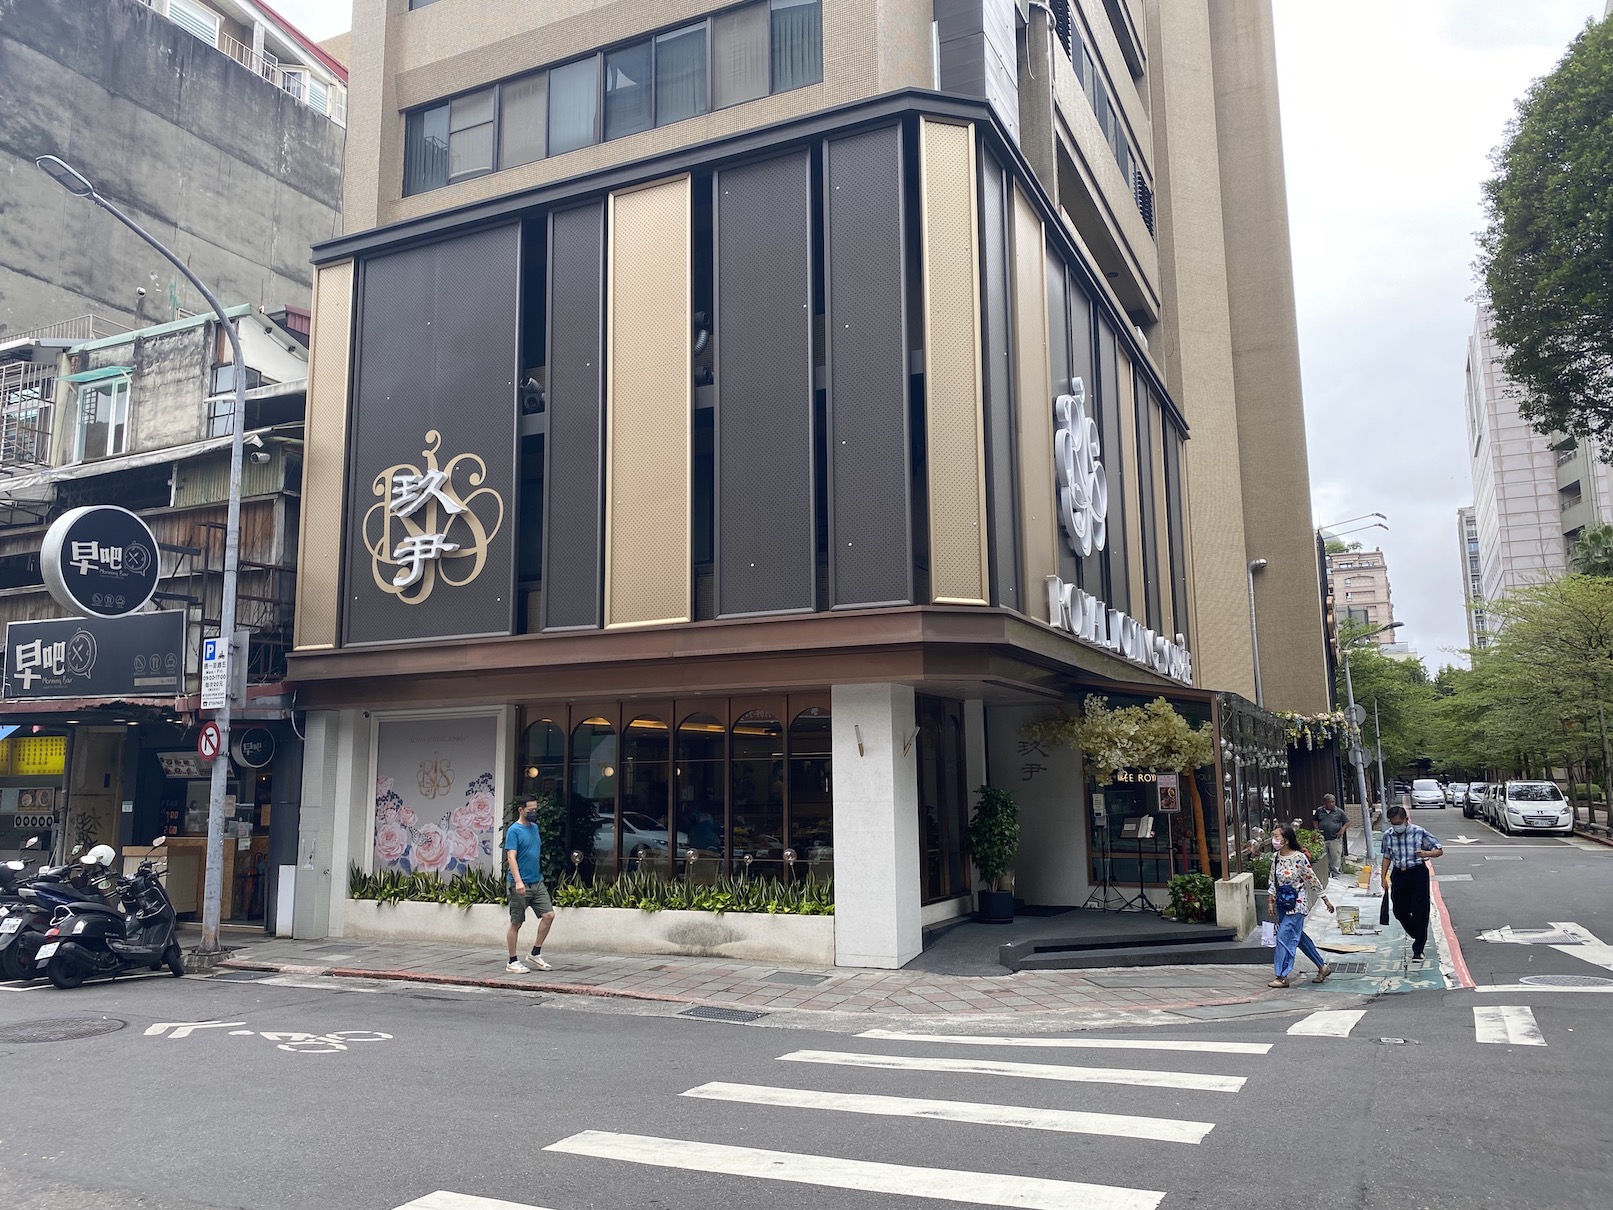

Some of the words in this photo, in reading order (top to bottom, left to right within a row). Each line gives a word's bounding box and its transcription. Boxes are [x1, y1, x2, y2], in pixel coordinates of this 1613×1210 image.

[389, 468, 468, 587] 玖尹
[69, 540, 123, 576] 早吧
[14, 639, 66, 690] 早吧
[42, 677, 62, 686] Morning
[62, 675, 73, 685] Bar
[1017, 741, 1050, 781] 玖尹
